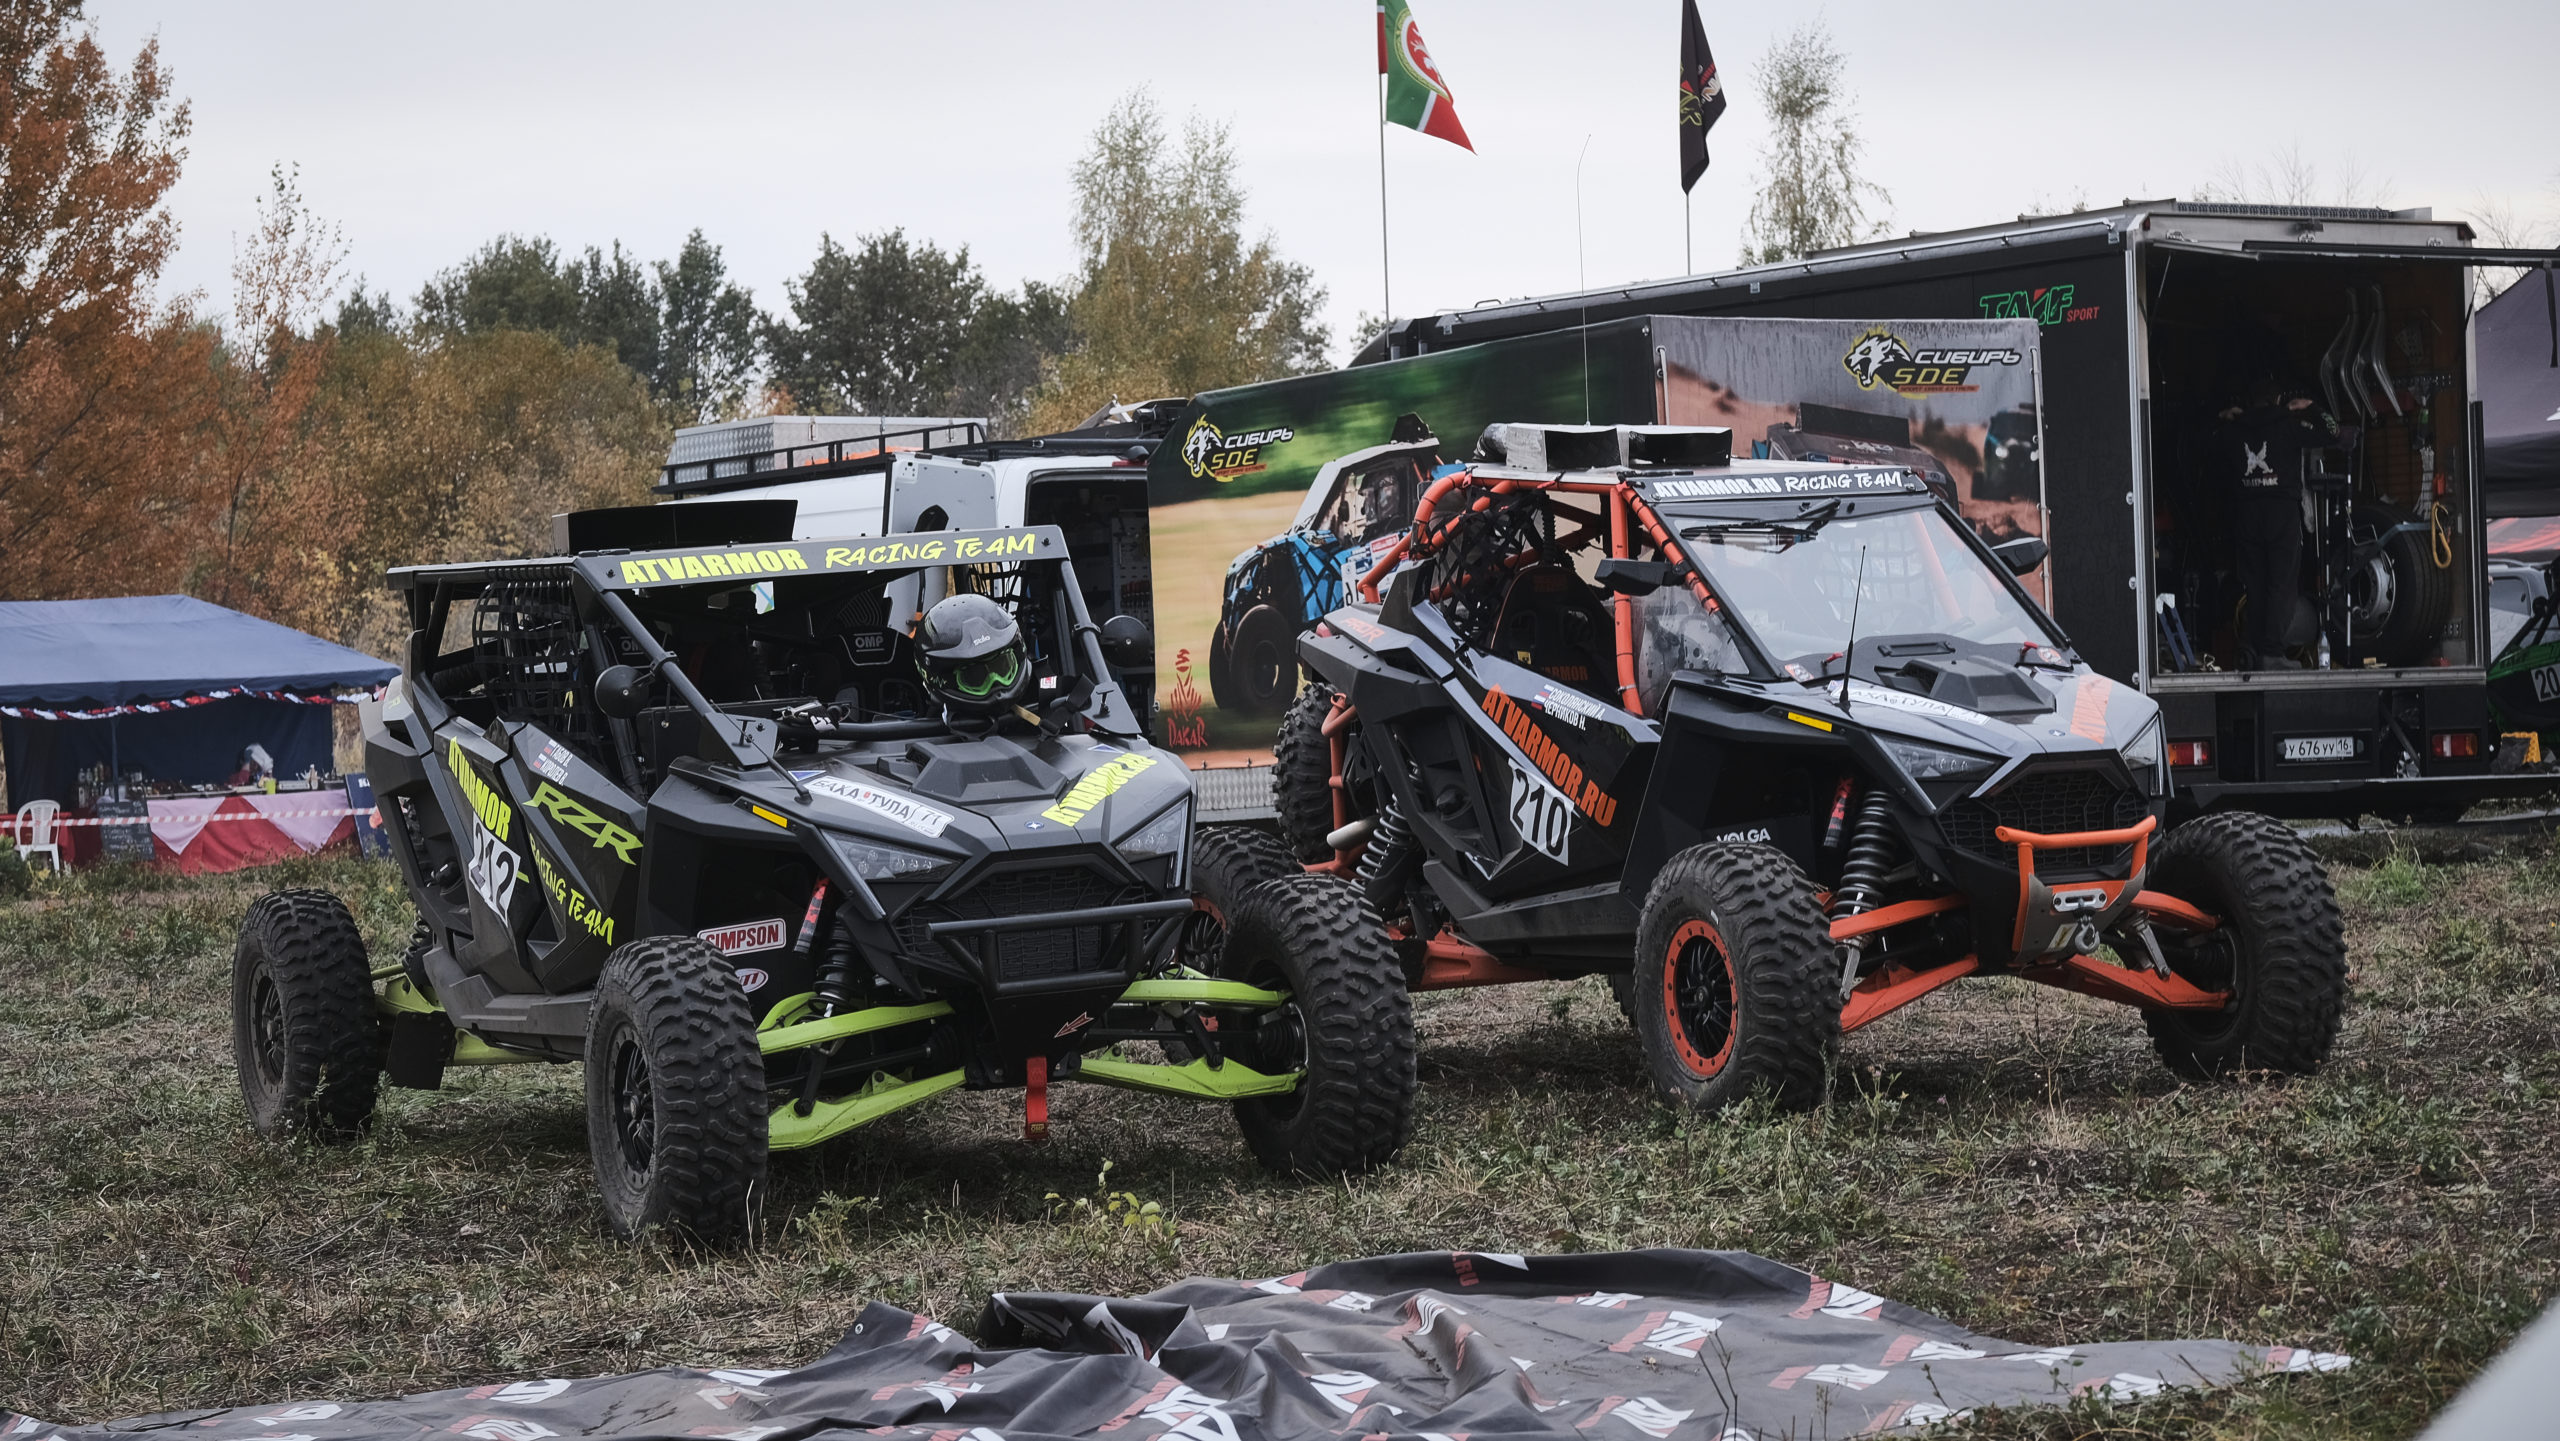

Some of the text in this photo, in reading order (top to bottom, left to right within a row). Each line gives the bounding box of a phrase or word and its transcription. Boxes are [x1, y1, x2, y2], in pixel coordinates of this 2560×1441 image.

[2066, 306, 2100, 322] SPORT
[1892, 367, 1965, 385] SDE
[1211, 448, 1258, 470] SDE
[1653, 471, 1903, 498] ATVARMOR.RU RACING TEAM
[620, 533, 1036, 584] ATVARMOR RACING TEAM
[621, 640, 642, 651] OM
[854, 635, 884, 649] OMP
[1167, 716, 1208, 748] DAKAR
[1481, 683, 1617, 827] ATVARMOR.RU
[449, 736, 511, 842] ATVARMOR
[812, 780, 910, 819] БАХА ТУЛА
[523, 781, 644, 866] RZR
[920, 809, 942, 826] 71
[1512, 767, 1568, 857] 210
[470, 822, 515, 922] 212
[529, 832, 567, 905] RACING
[568, 887, 615, 946] TEAM
[705, 923, 779, 950] SIMPSON
